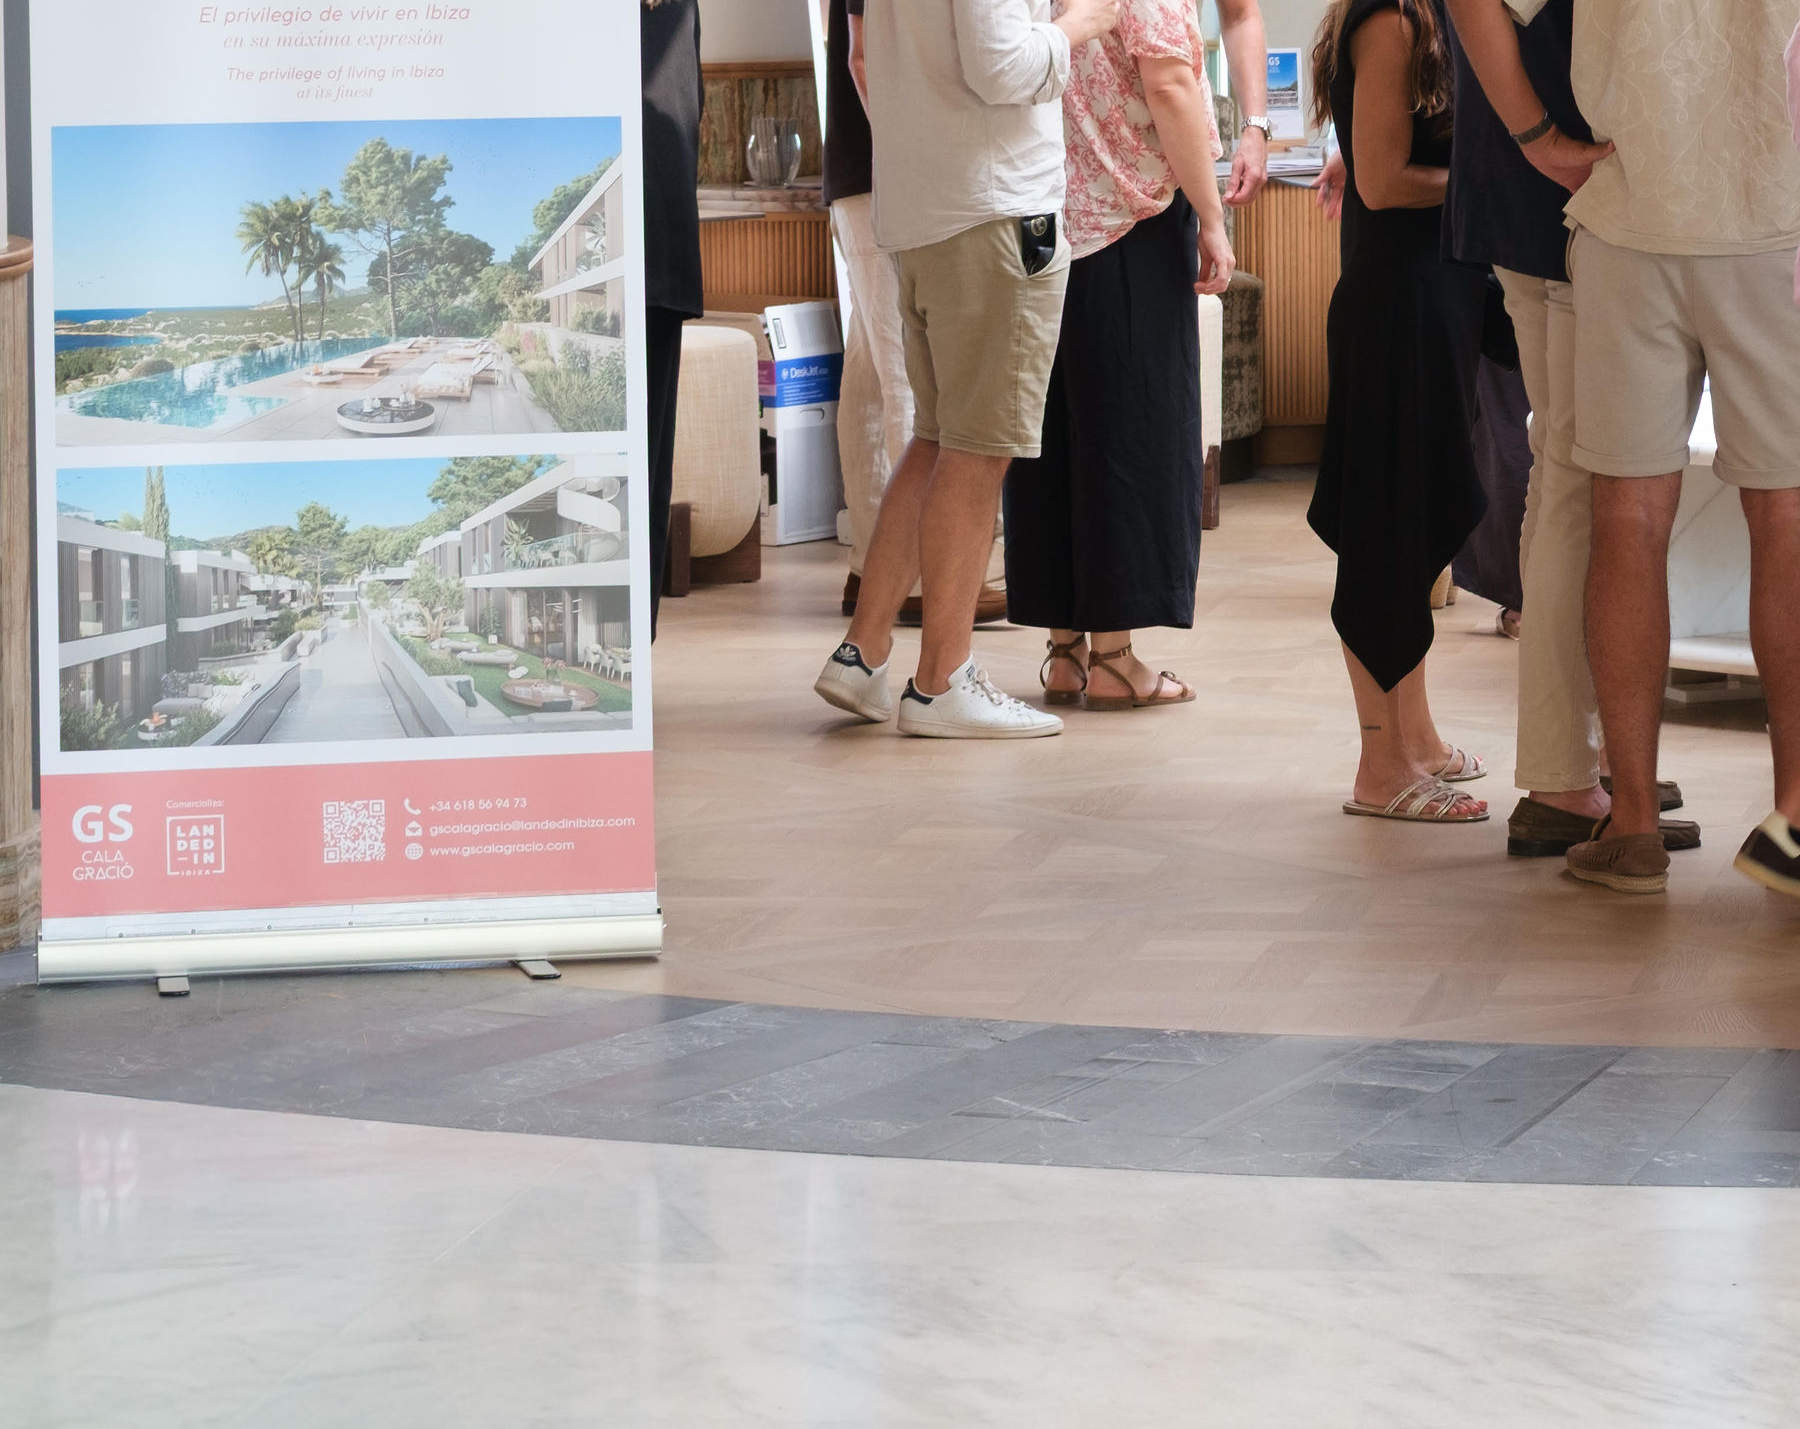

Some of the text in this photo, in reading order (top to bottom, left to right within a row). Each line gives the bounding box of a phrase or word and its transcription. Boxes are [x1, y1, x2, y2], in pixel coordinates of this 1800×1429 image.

[199, 3, 471, 27] El privilegio de vivir en Ibiza
[223, 28, 444, 51] en su máxima expresión
[1268, 56, 1280, 66] GS
[227, 64, 445, 84] The privilege of living in Ibiza
[297, 85, 373, 102] at its finest
[429, 797, 527, 812] +34 618 56 94 73
[72, 803, 134, 844] GS
[176, 824, 215, 838] LAN
[429, 817, 636, 837] gscalagracio@landedinibiza.com
[176, 838, 215, 852] DED
[429, 841, 575, 857] www.gscalagracio.com
[81, 849, 125, 864] CALA
[72, 861, 134, 881] GRACIÓ
